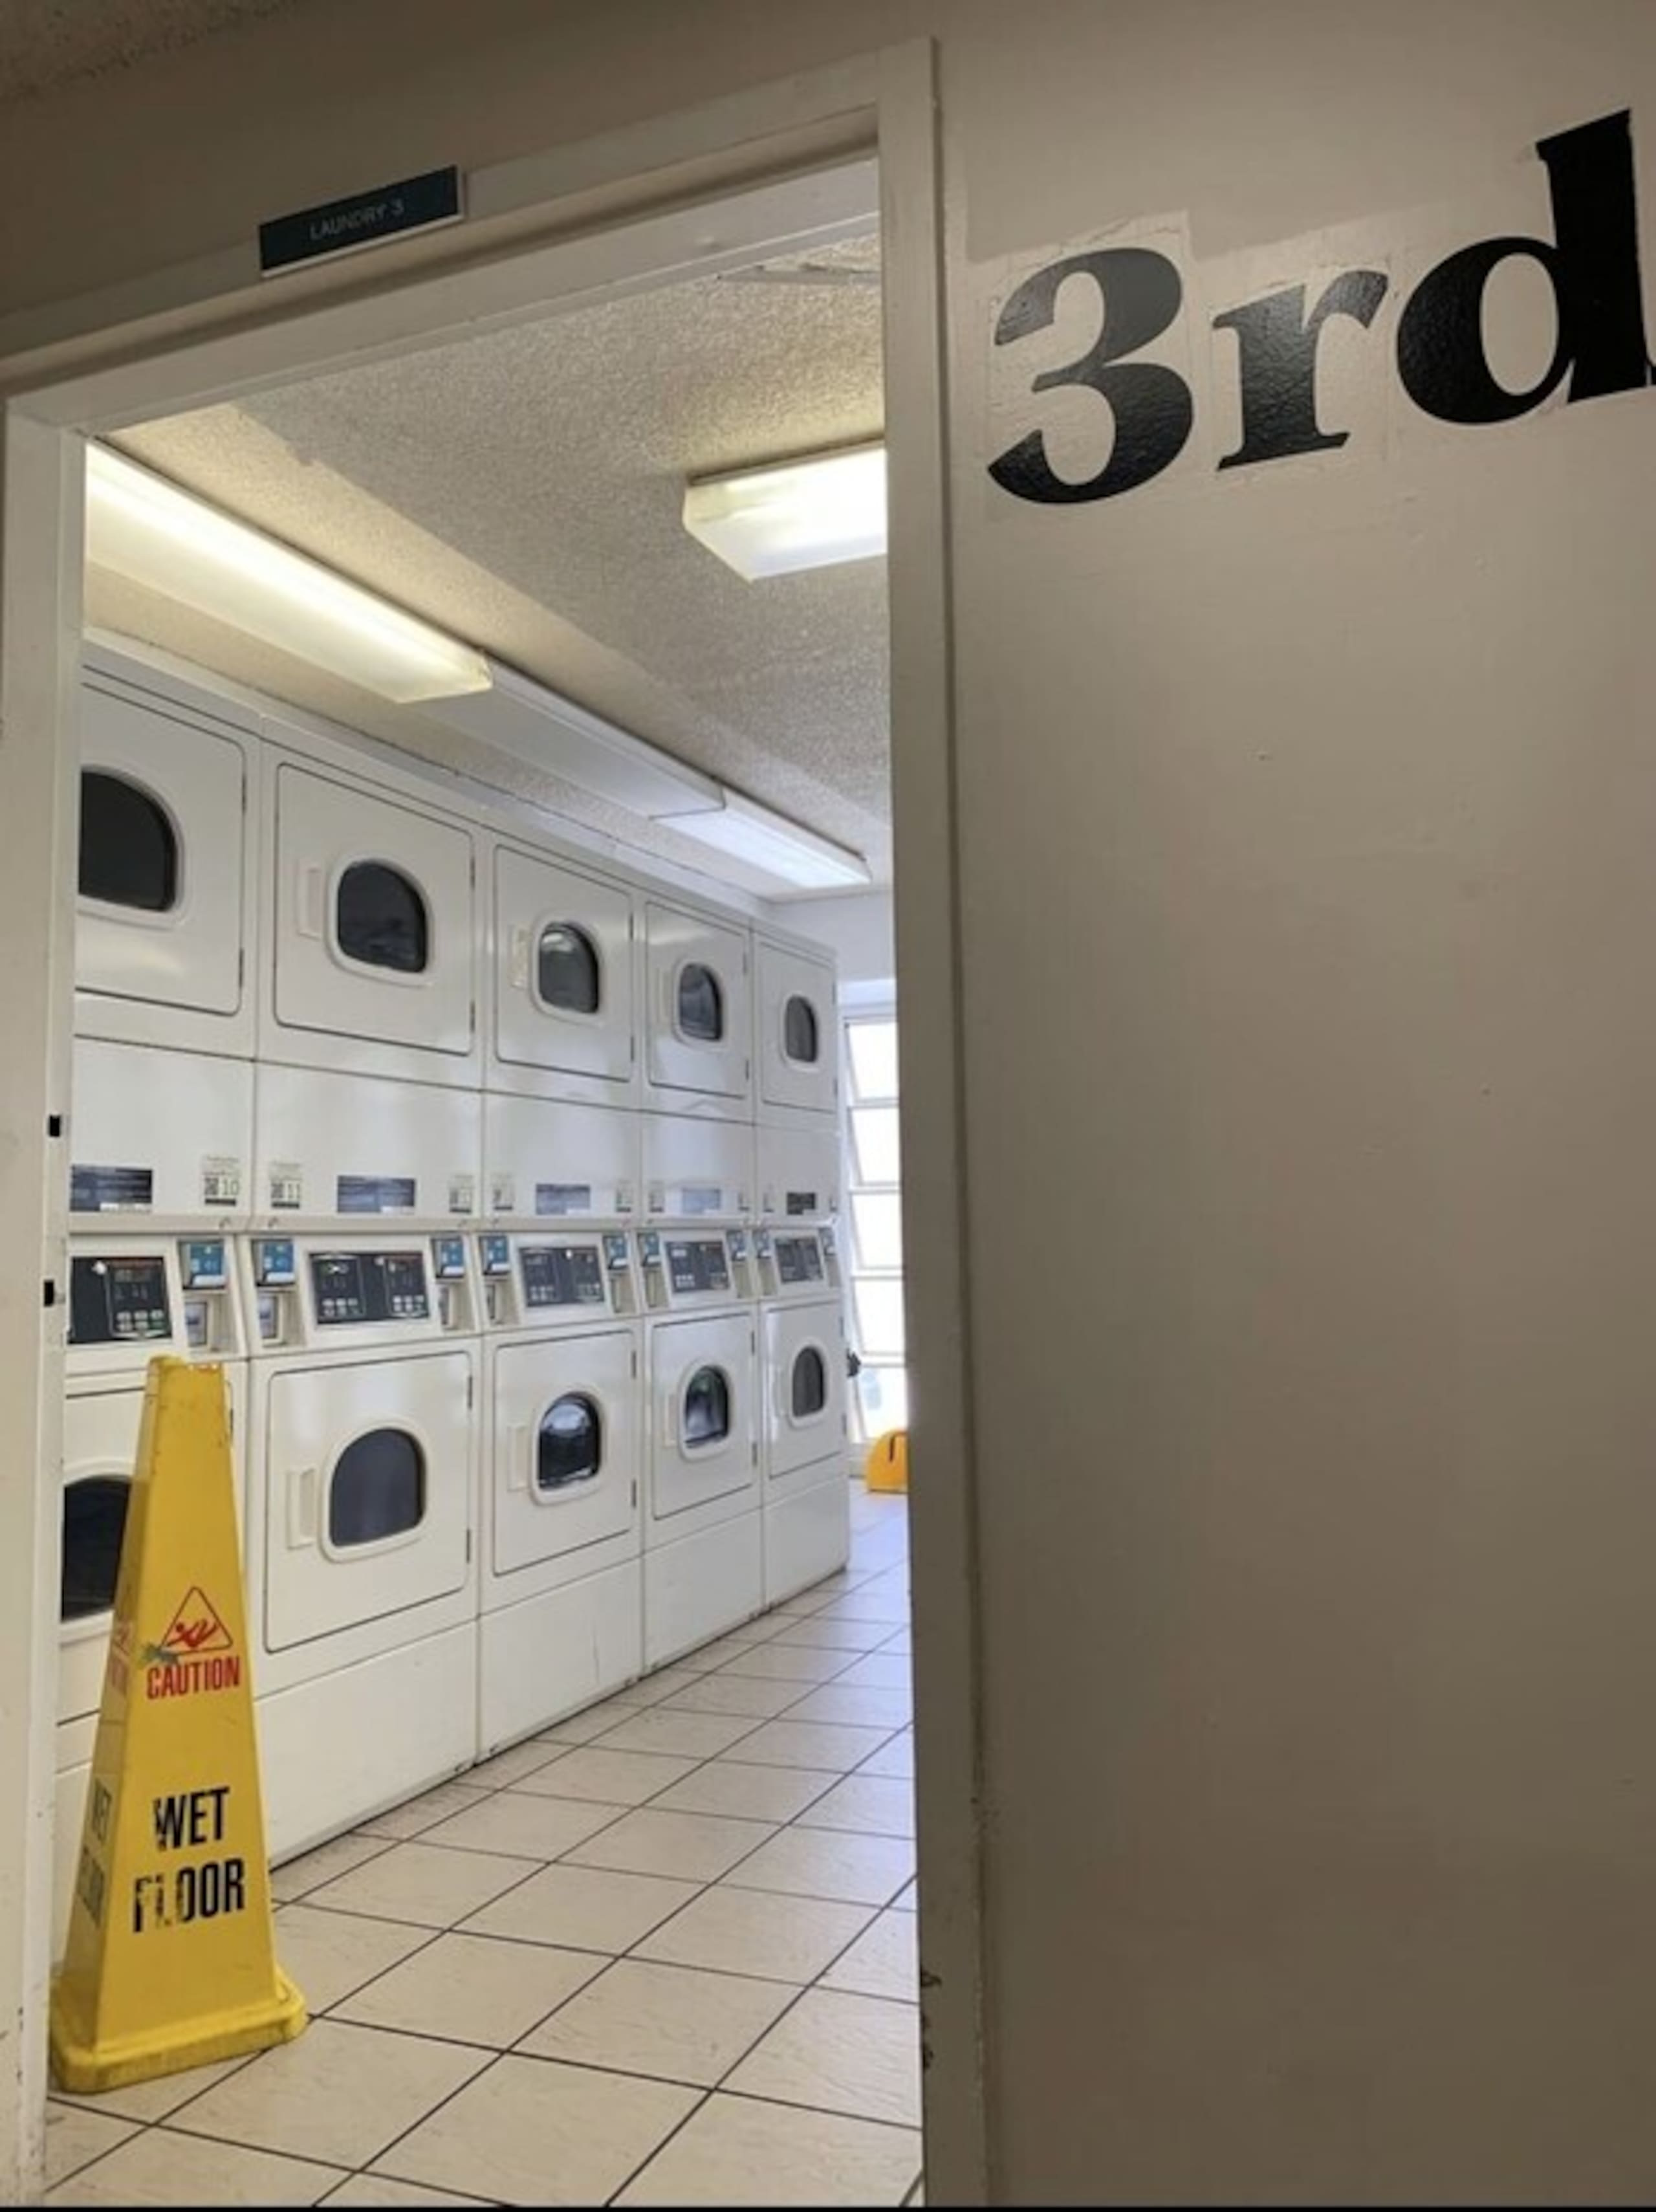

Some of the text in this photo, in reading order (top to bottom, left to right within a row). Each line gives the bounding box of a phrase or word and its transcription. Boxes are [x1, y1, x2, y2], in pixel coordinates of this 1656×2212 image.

[310, 199, 404, 240] LAUNDRY 3
[986, 108, 1656, 504] 3rd
[147, 1656, 240, 1699] CAUTION
[153, 1786, 230, 1852] WET
